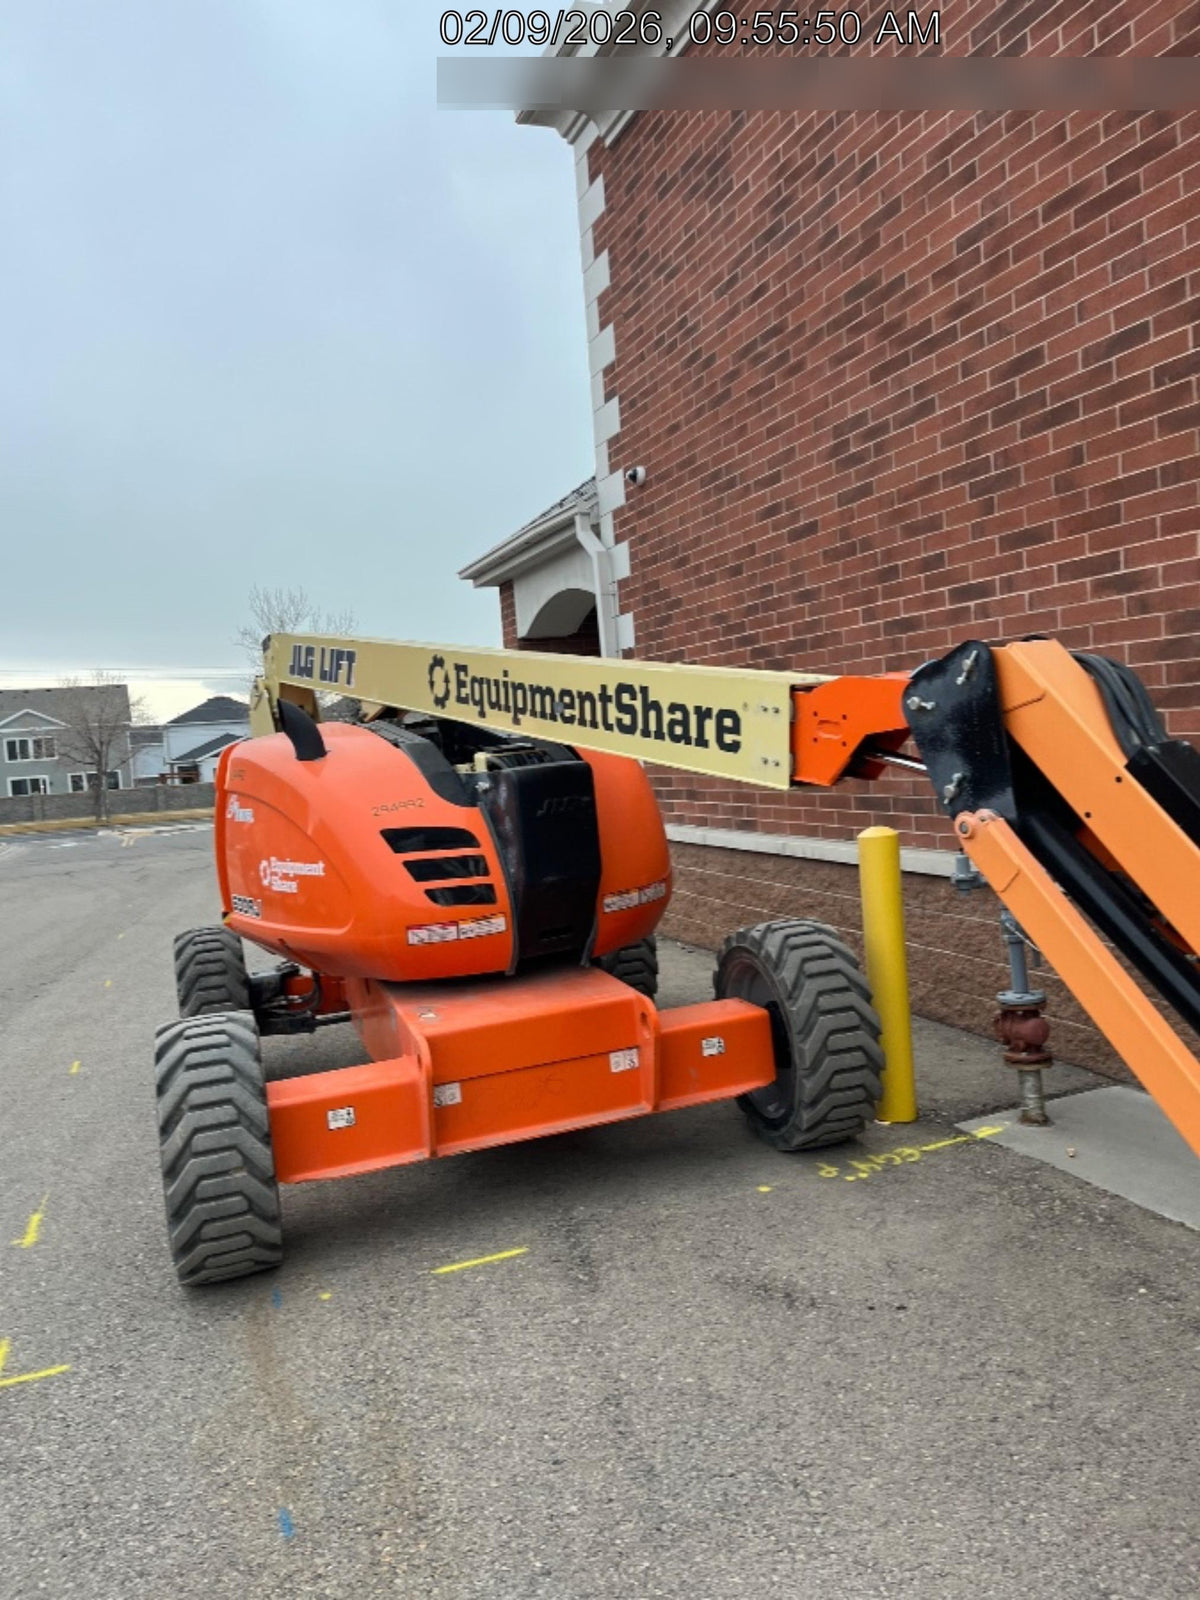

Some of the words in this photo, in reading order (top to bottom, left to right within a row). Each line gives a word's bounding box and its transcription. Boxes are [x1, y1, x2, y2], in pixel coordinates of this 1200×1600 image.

[289, 644, 316, 680] JLG
[319, 646, 357, 688] LIFT
[454, 662, 742, 754] EquipmentShare
